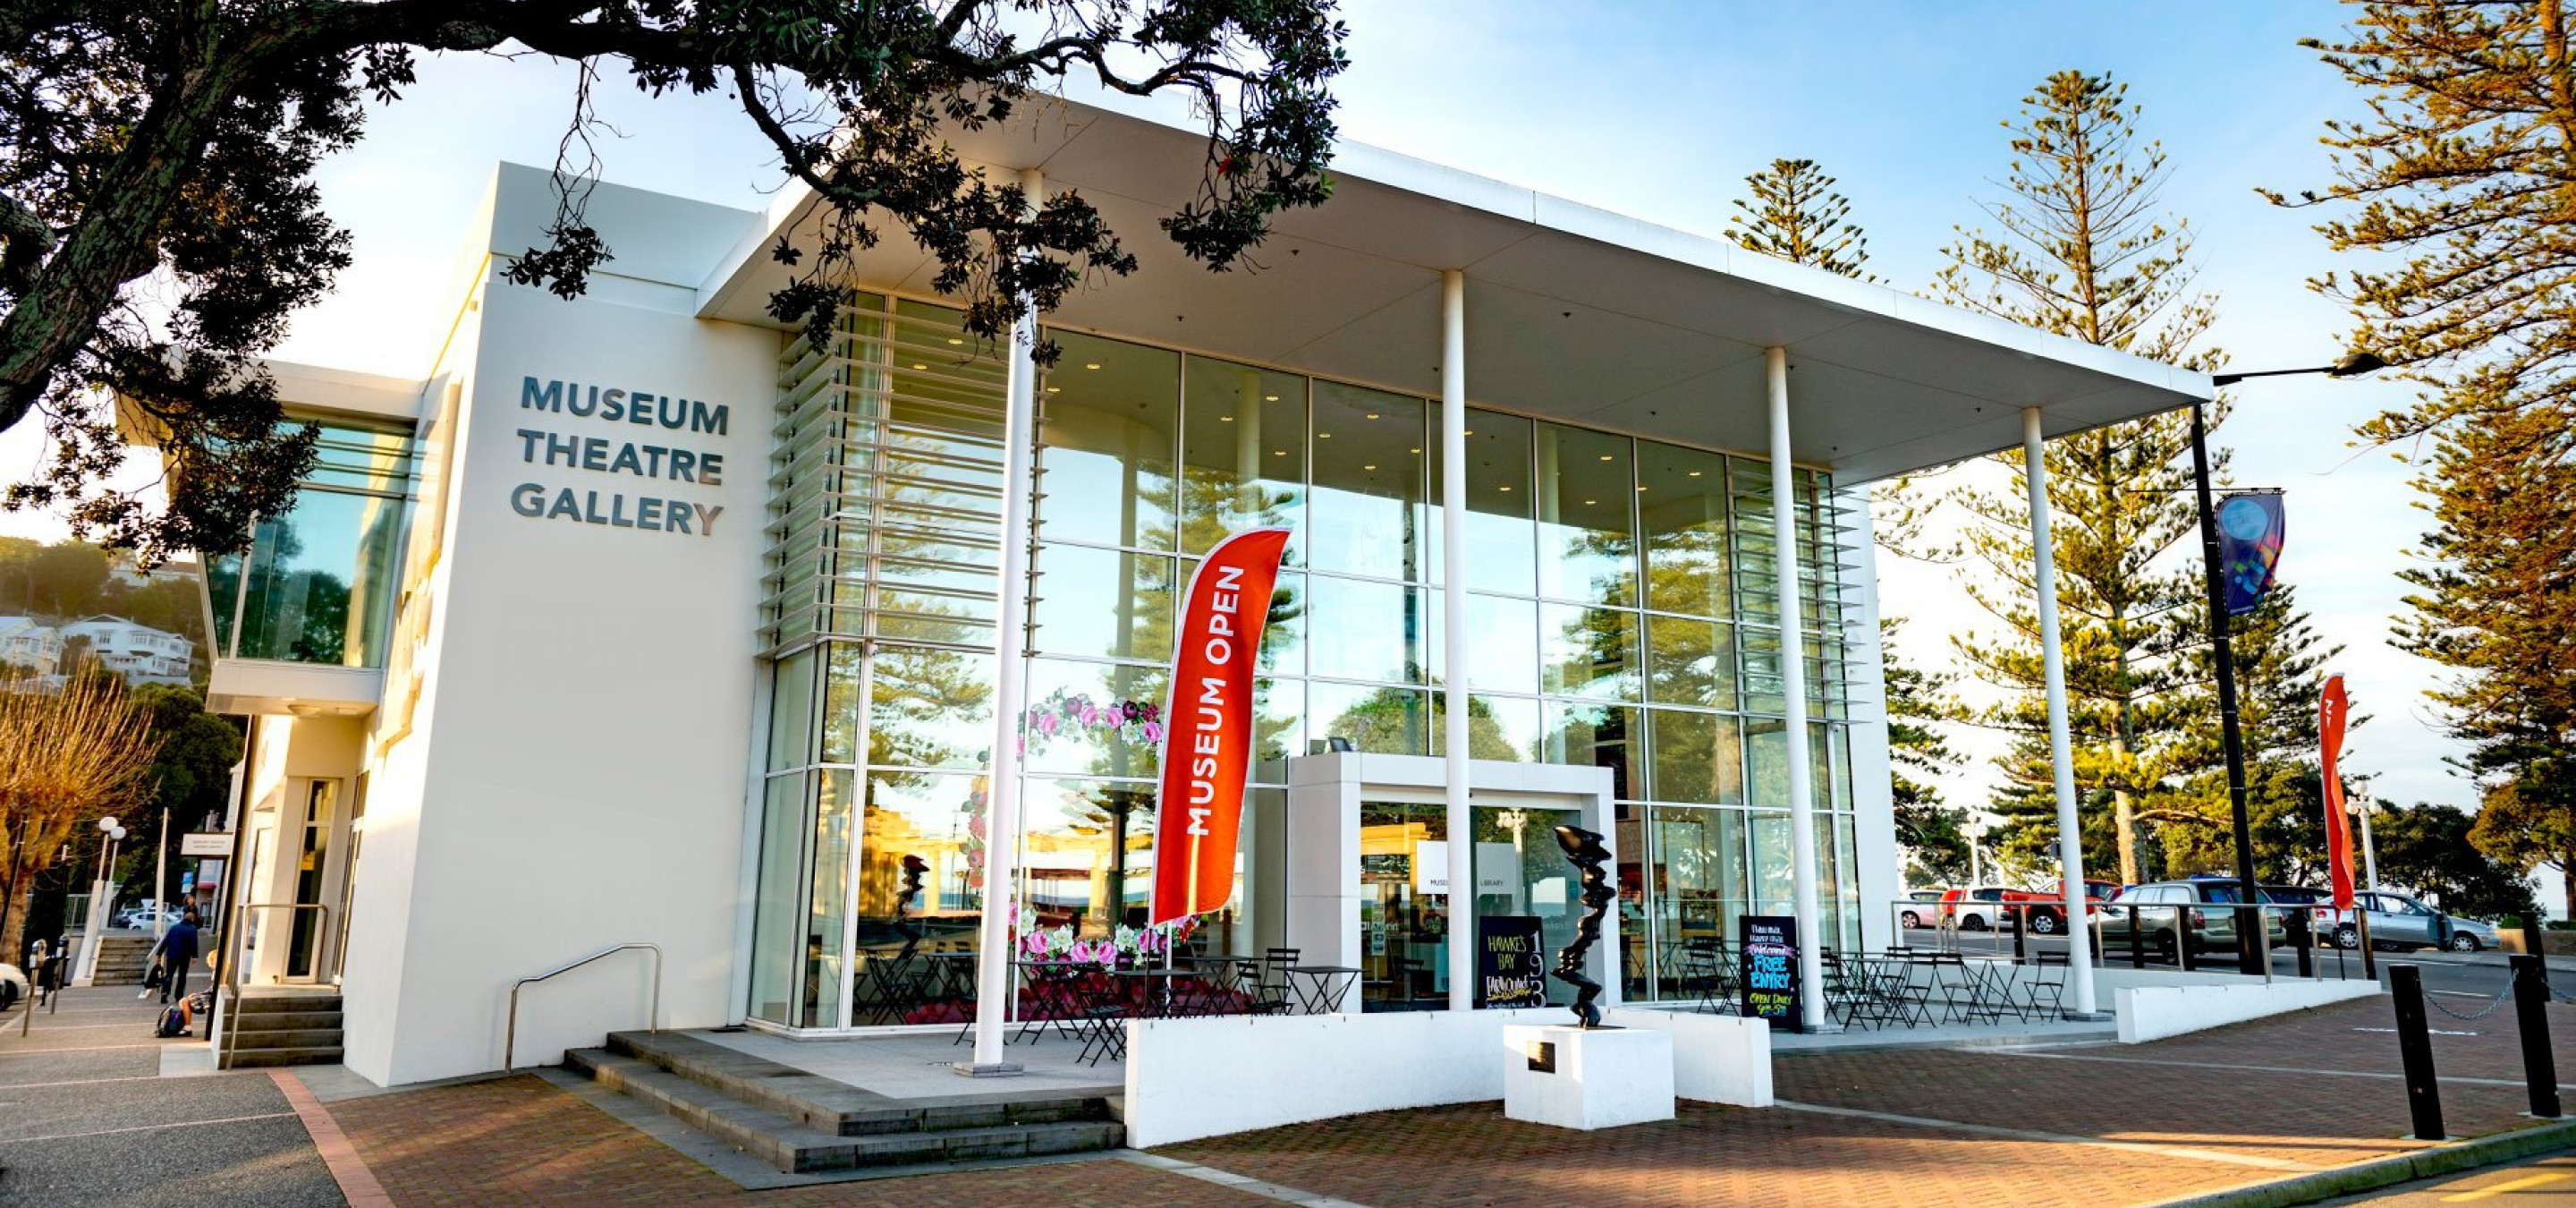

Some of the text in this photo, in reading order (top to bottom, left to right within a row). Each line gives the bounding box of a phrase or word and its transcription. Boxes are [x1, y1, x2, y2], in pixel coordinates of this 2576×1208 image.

[521, 376, 729, 436] MUSEUM
[517, 429, 724, 486] THEATRE
[511, 483, 724, 536] GALLERY
[1187, 566, 1245, 836] MUSEUM OPEN
[1479, 879, 1504, 887] LIBRARY
[1497, 953, 1516, 971] BAY
[1754, 955, 1787, 972] FREE
[1750, 972, 1791, 989] ENTRY
